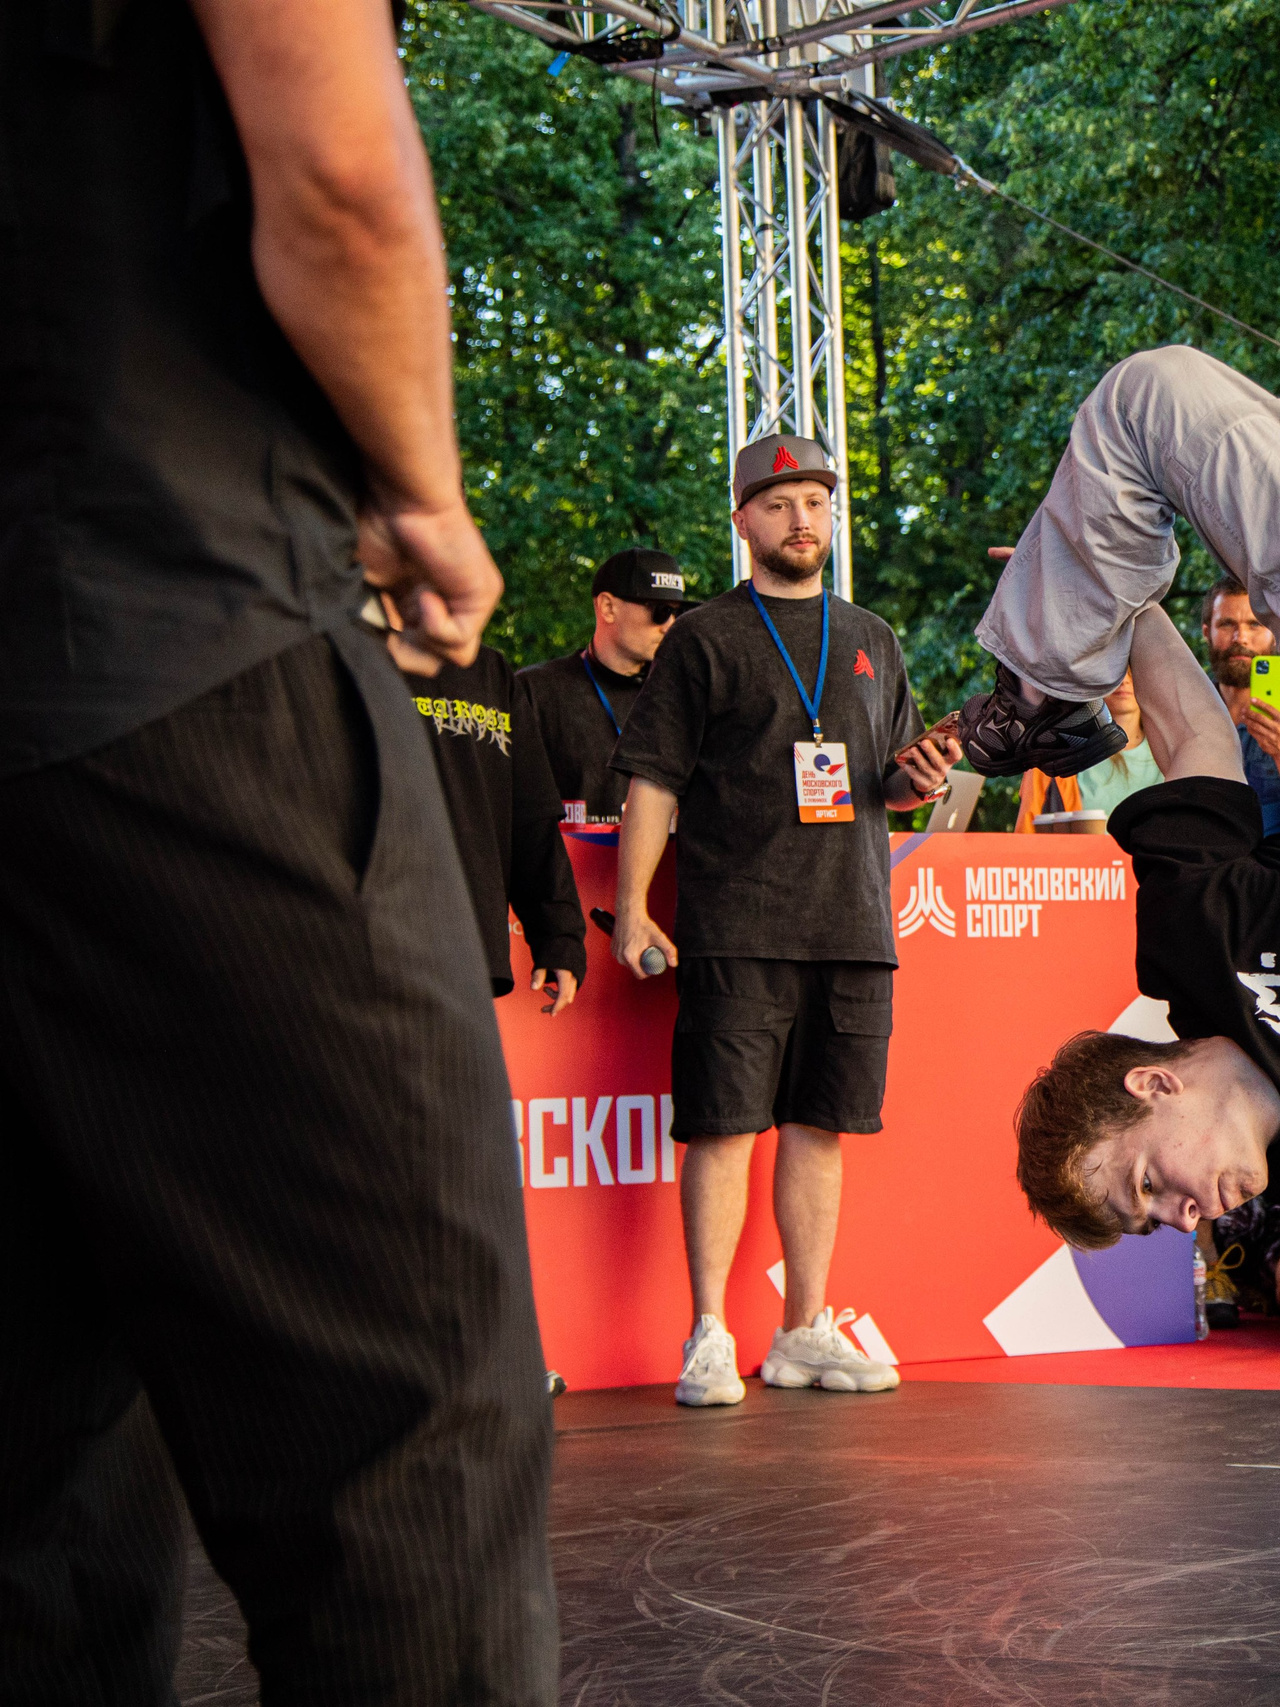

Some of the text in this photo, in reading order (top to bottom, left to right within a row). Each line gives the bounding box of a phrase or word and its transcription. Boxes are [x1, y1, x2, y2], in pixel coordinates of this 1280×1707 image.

[803, 788, 825, 796] СПОРТА
[815, 809, 837, 818] АРТИСТ
[965, 860, 1125, 901] МОСКОВСКИЙ
[966, 904, 1042, 937] СПОРТ
